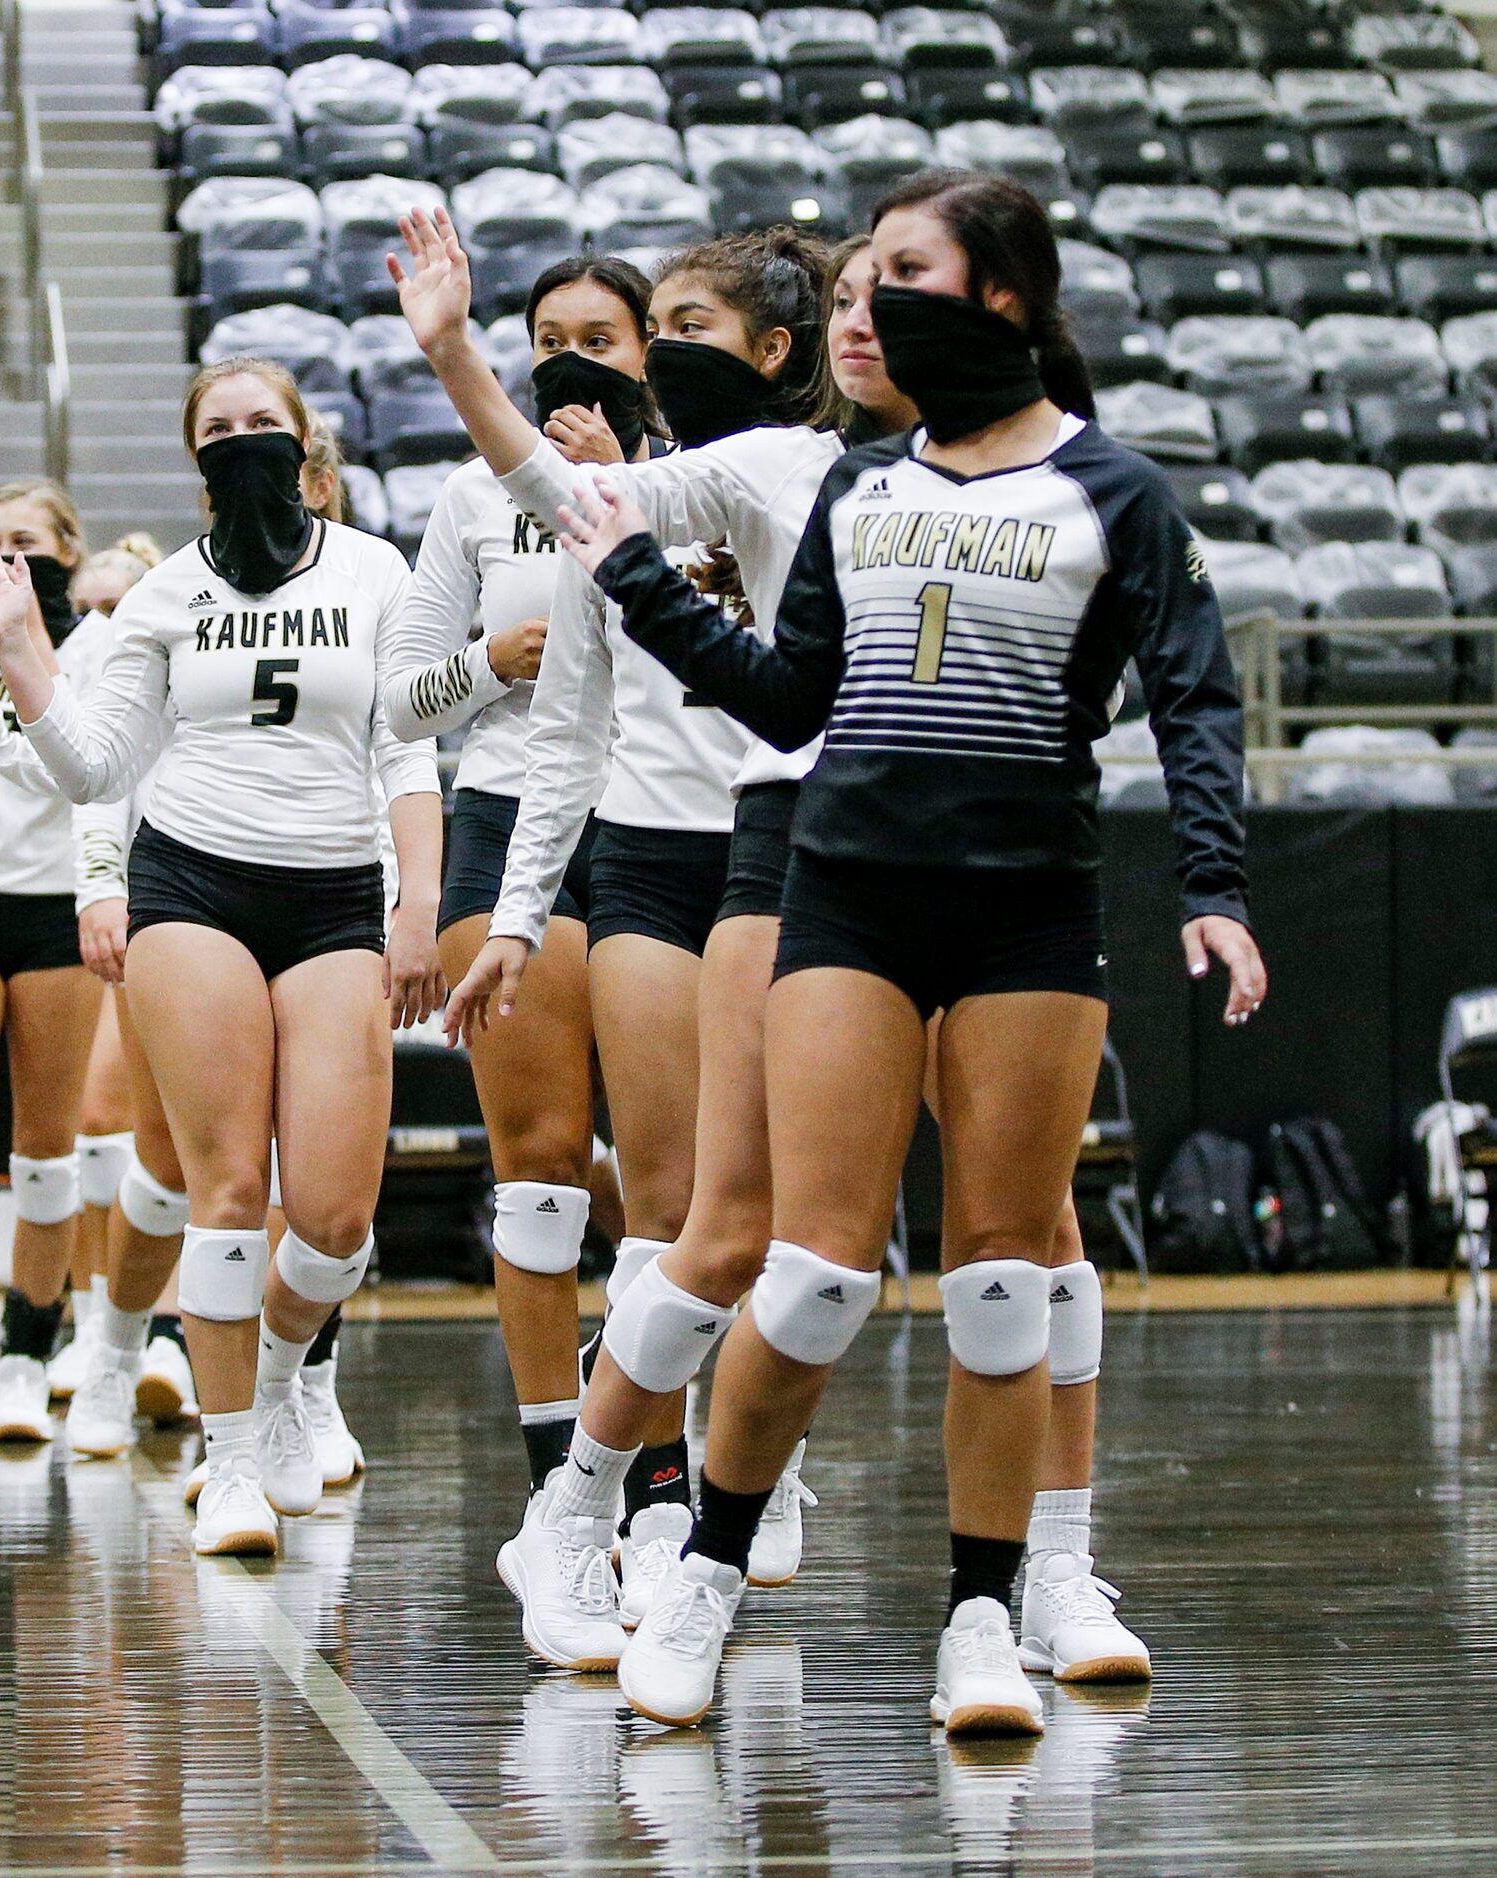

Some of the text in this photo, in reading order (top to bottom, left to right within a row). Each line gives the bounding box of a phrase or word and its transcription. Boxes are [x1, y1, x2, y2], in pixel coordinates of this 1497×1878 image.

[852, 511, 1057, 583] KAUFMAN
[187, 599, 218, 609] adidas
[195, 607, 350, 652] KAUFMAN
[909, 581, 953, 685] 1
[250, 658, 300, 727] 5
